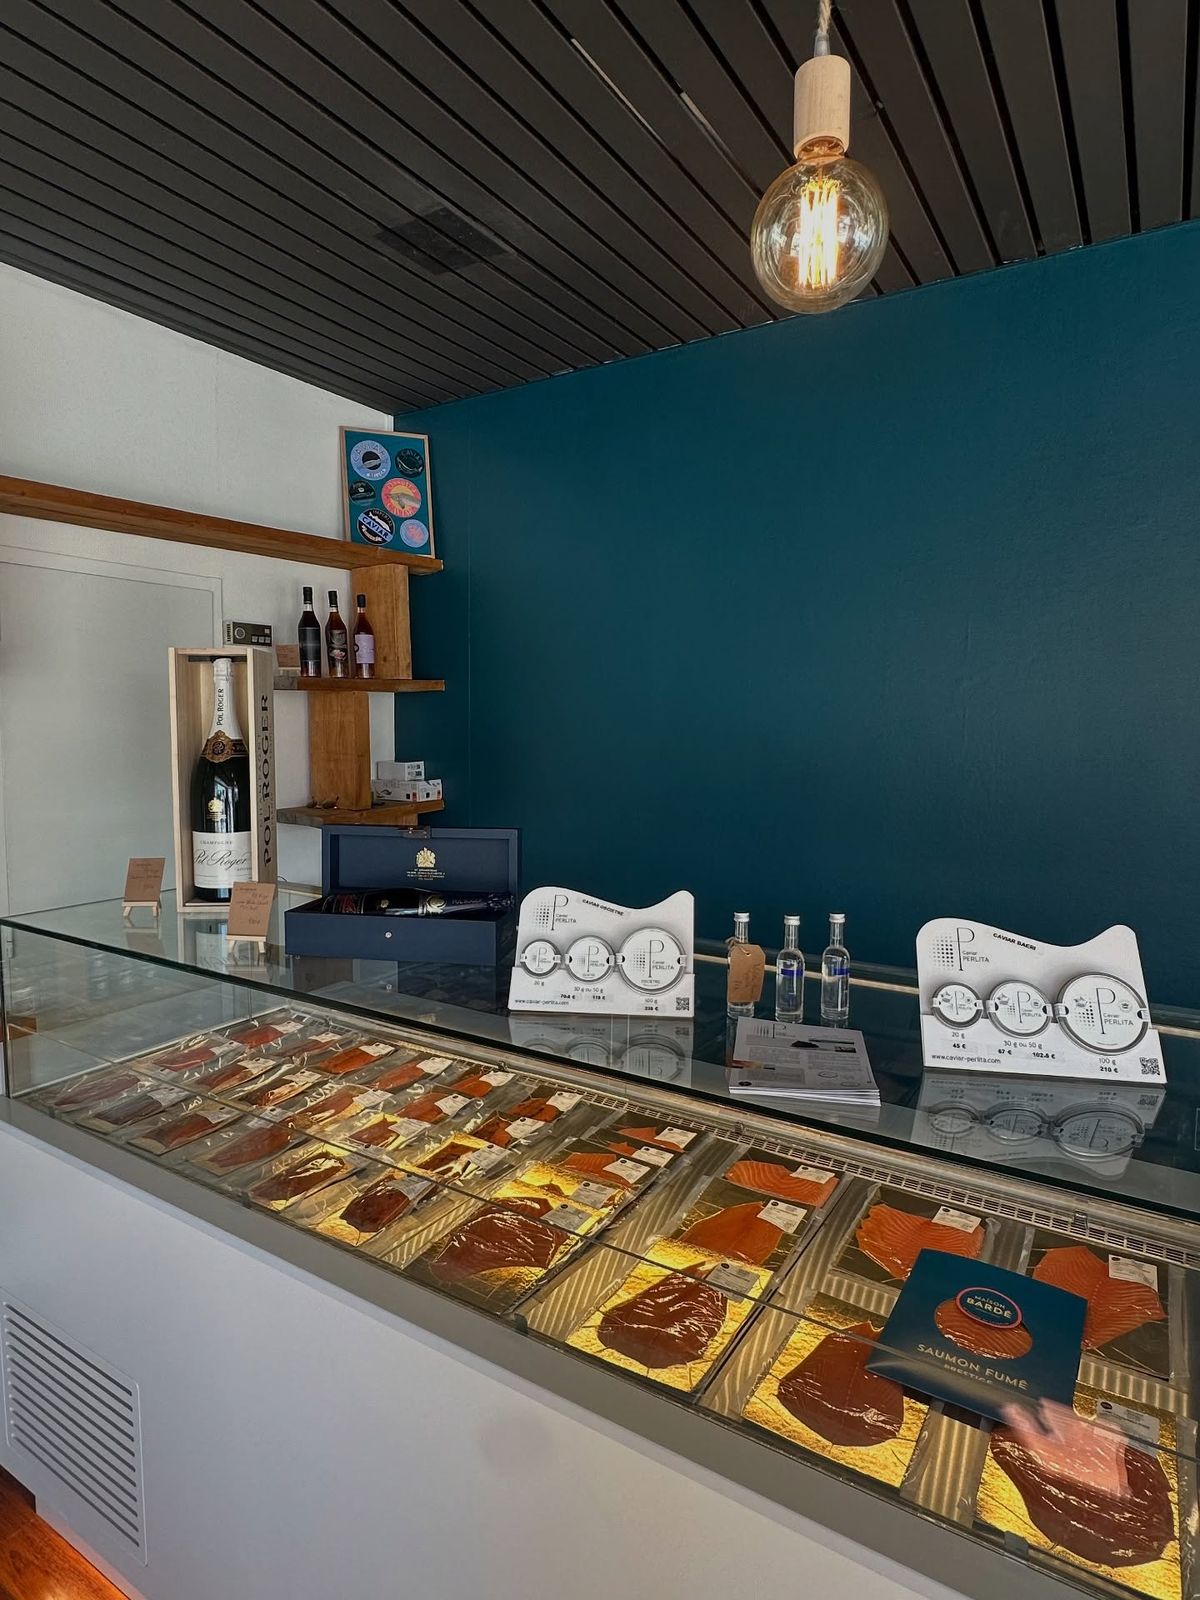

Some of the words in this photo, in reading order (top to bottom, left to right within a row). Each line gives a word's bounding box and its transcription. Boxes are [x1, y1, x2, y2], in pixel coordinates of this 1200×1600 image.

[362, 517, 389, 539] CAVIAR
[262, 695, 270, 801] ROGER
[207, 849, 247, 871] Roger
[582, 898, 600, 908] CAVIAR
[993, 932, 1016, 945] CAVIAR
[1016, 939, 1037, 951] BAERI
[514, 999, 570, 1007] www.caviar-perlita.com
[1003, 1040, 1012, 1048] 30
[931, 1054, 1001, 1064] www.caviar-perlita.com
[966, 1297, 1013, 1319] BARDÉ
[916, 1343, 980, 1371] SAUMON
[985, 1366, 1030, 1391] FUMÉ
